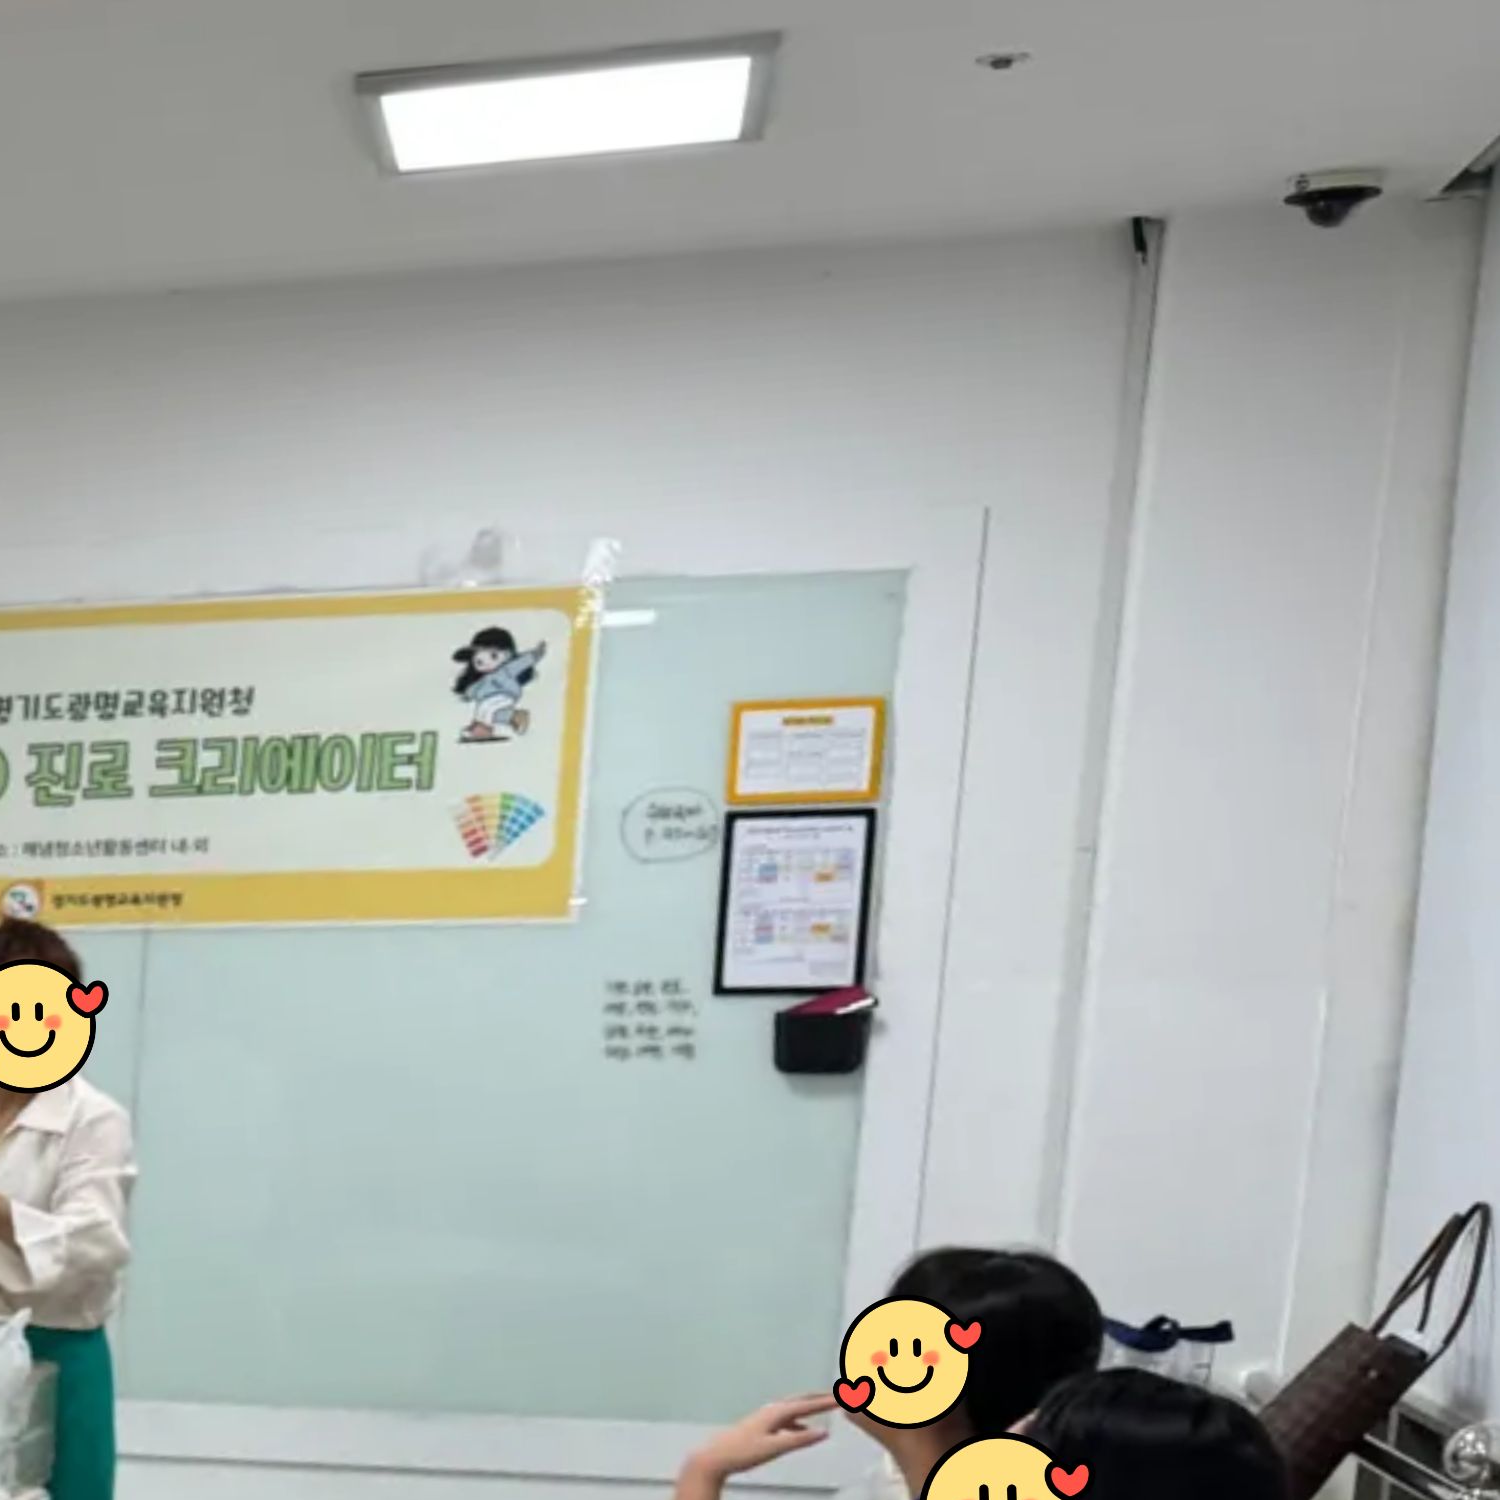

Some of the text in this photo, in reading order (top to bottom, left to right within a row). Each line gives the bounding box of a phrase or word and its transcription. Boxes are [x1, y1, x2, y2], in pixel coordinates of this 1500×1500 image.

[24, 739, 134, 807] 진로
[148, 729, 439, 798] 크리에이터
[21, 837, 168, 859] 해냄청소년활동센터
